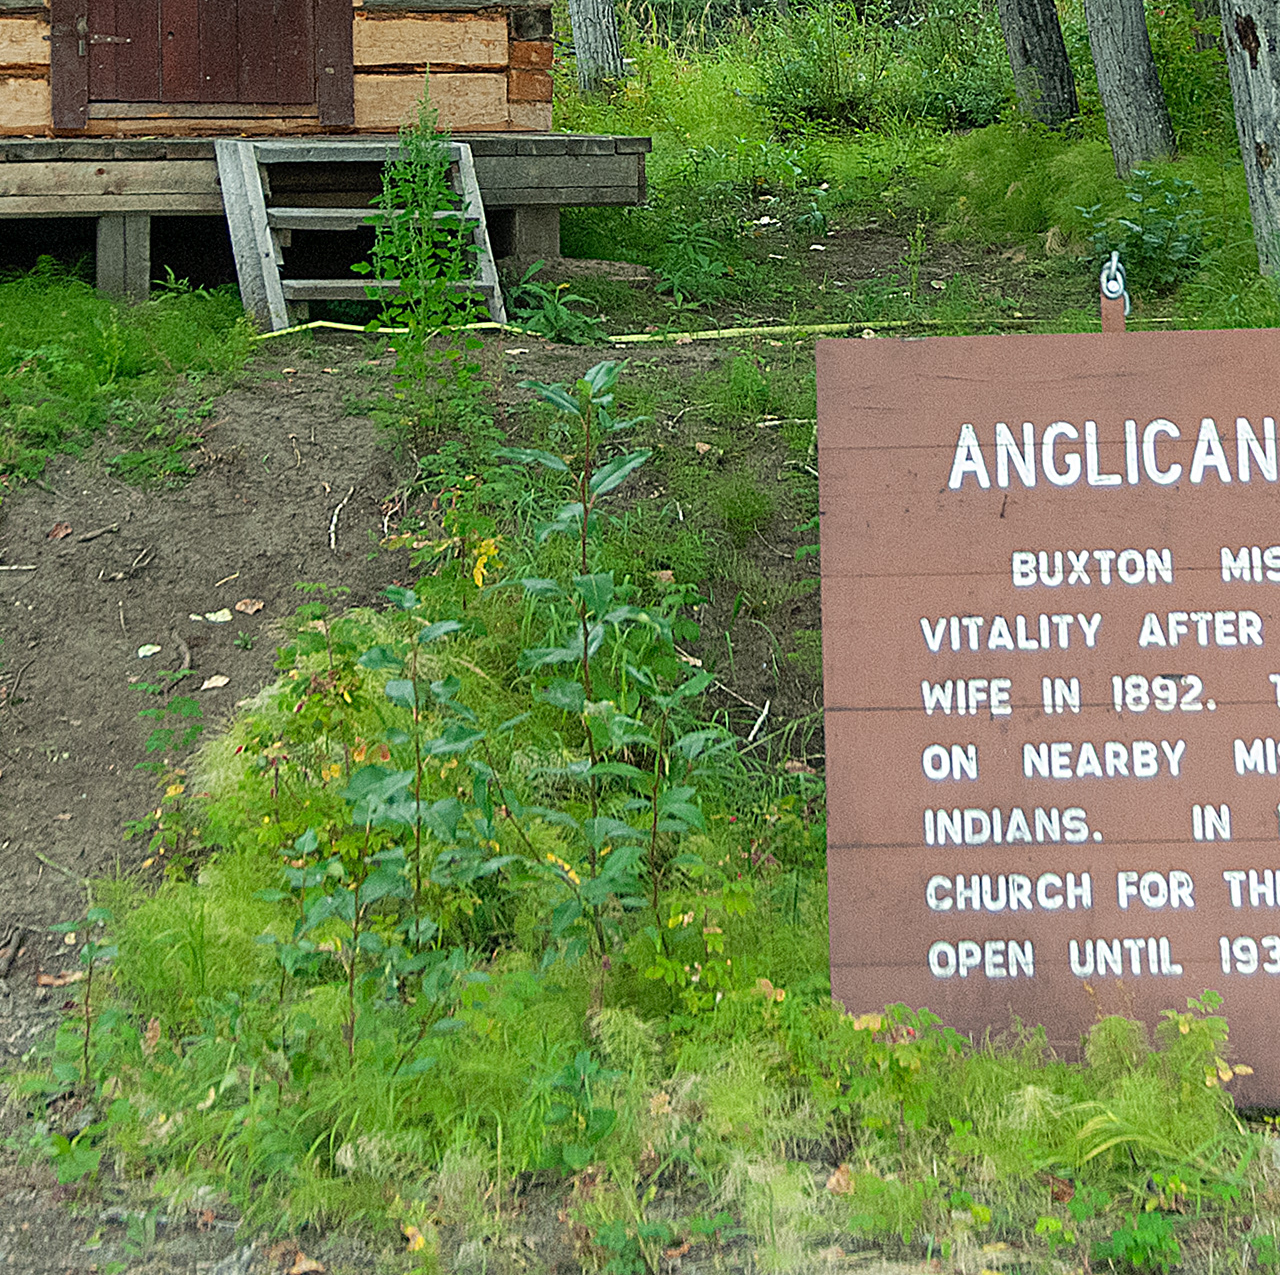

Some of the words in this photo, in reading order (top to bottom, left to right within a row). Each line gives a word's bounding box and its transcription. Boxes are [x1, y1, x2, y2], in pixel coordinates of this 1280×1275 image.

[948, 417, 1278, 490] ANGLICAN
[1012, 548, 1173, 587] BUXTON
[920, 612, 1102, 653] VITALITY
[1138, 610, 1264, 649] AFTER
[921, 678, 1013, 716] WIFE
[1042, 677, 1080, 715] IN
[922, 744, 978, 781] ON
[1023, 739, 1186, 780] NEARBY
[1192, 803, 1231, 841] IN
[926, 872, 1092, 912] CHURCH
[1117, 870, 1195, 910] FOR
[928, 940, 1034, 978] OPEN
[1069, 936, 1184, 978] UNTIL
